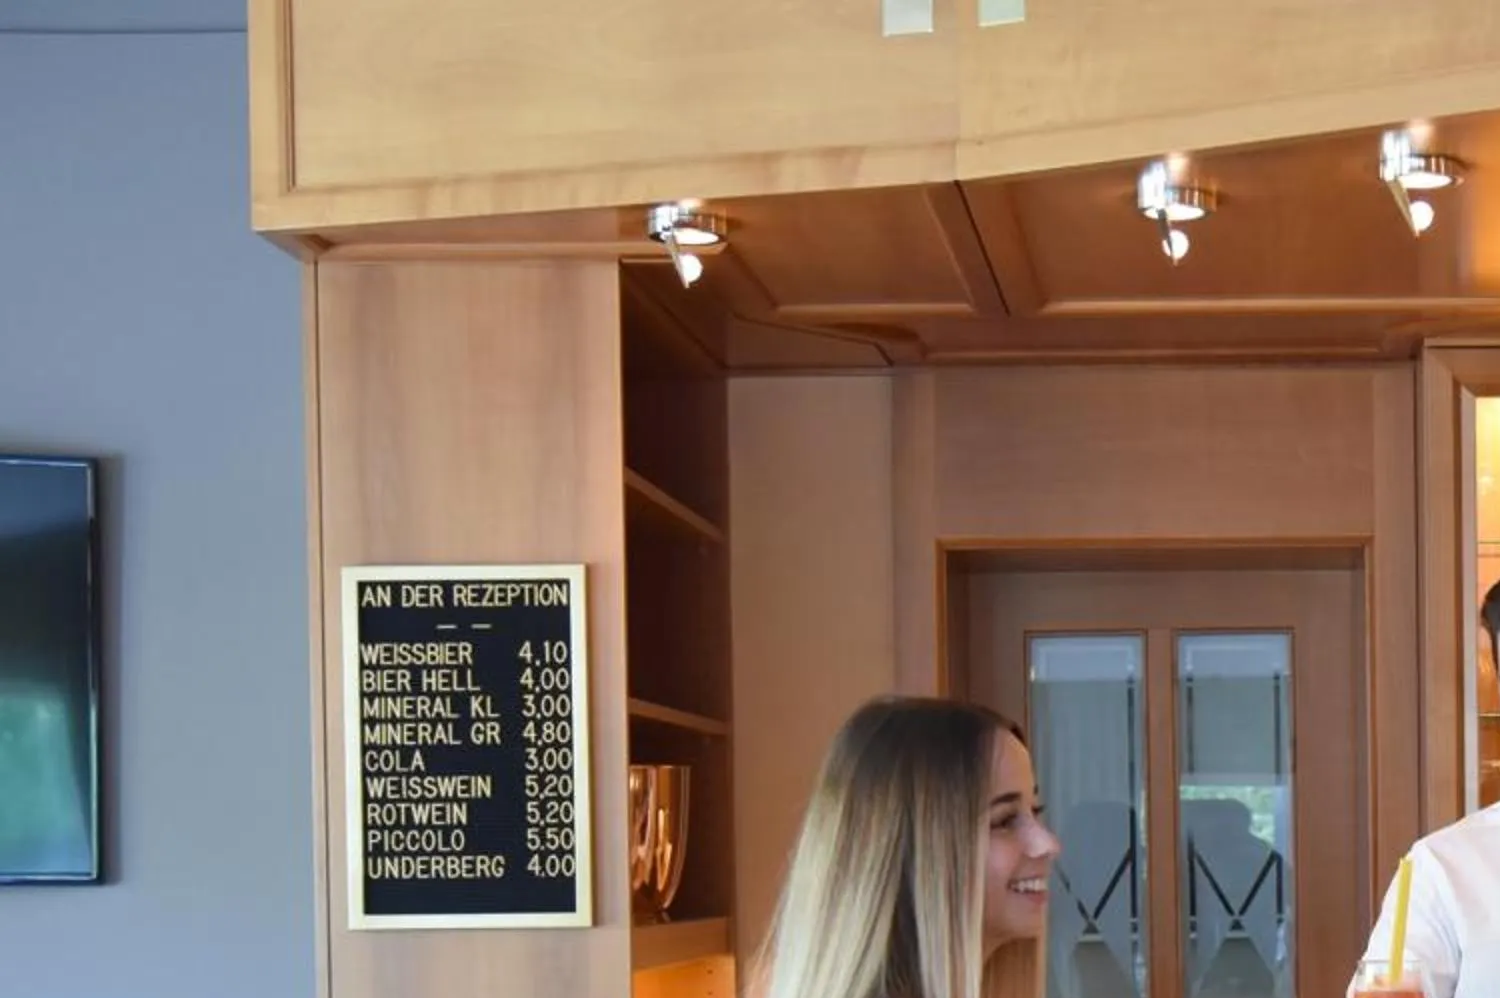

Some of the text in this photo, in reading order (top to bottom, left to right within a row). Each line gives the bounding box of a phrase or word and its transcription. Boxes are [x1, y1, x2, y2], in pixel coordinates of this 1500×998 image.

[362, 584, 567, 607] AN DER REZEPTION
[360, 641, 567, 666] WEISSBIER 4.10
[363, 668, 570, 692] BIER HELL 4.00
[364, 694, 570, 719] MINERAL KL 3.00
[365, 721, 570, 745] MINERAL GR 4.80
[366, 748, 573, 772] COLA 3.00
[366, 774, 574, 799] WEISSWEIN 5.20
[368, 801, 574, 825] ROTWEIN 5.20
[368, 828, 575, 851] PICCOLO 5.50
[368, 855, 576, 879] UNDERBERG 4.00
